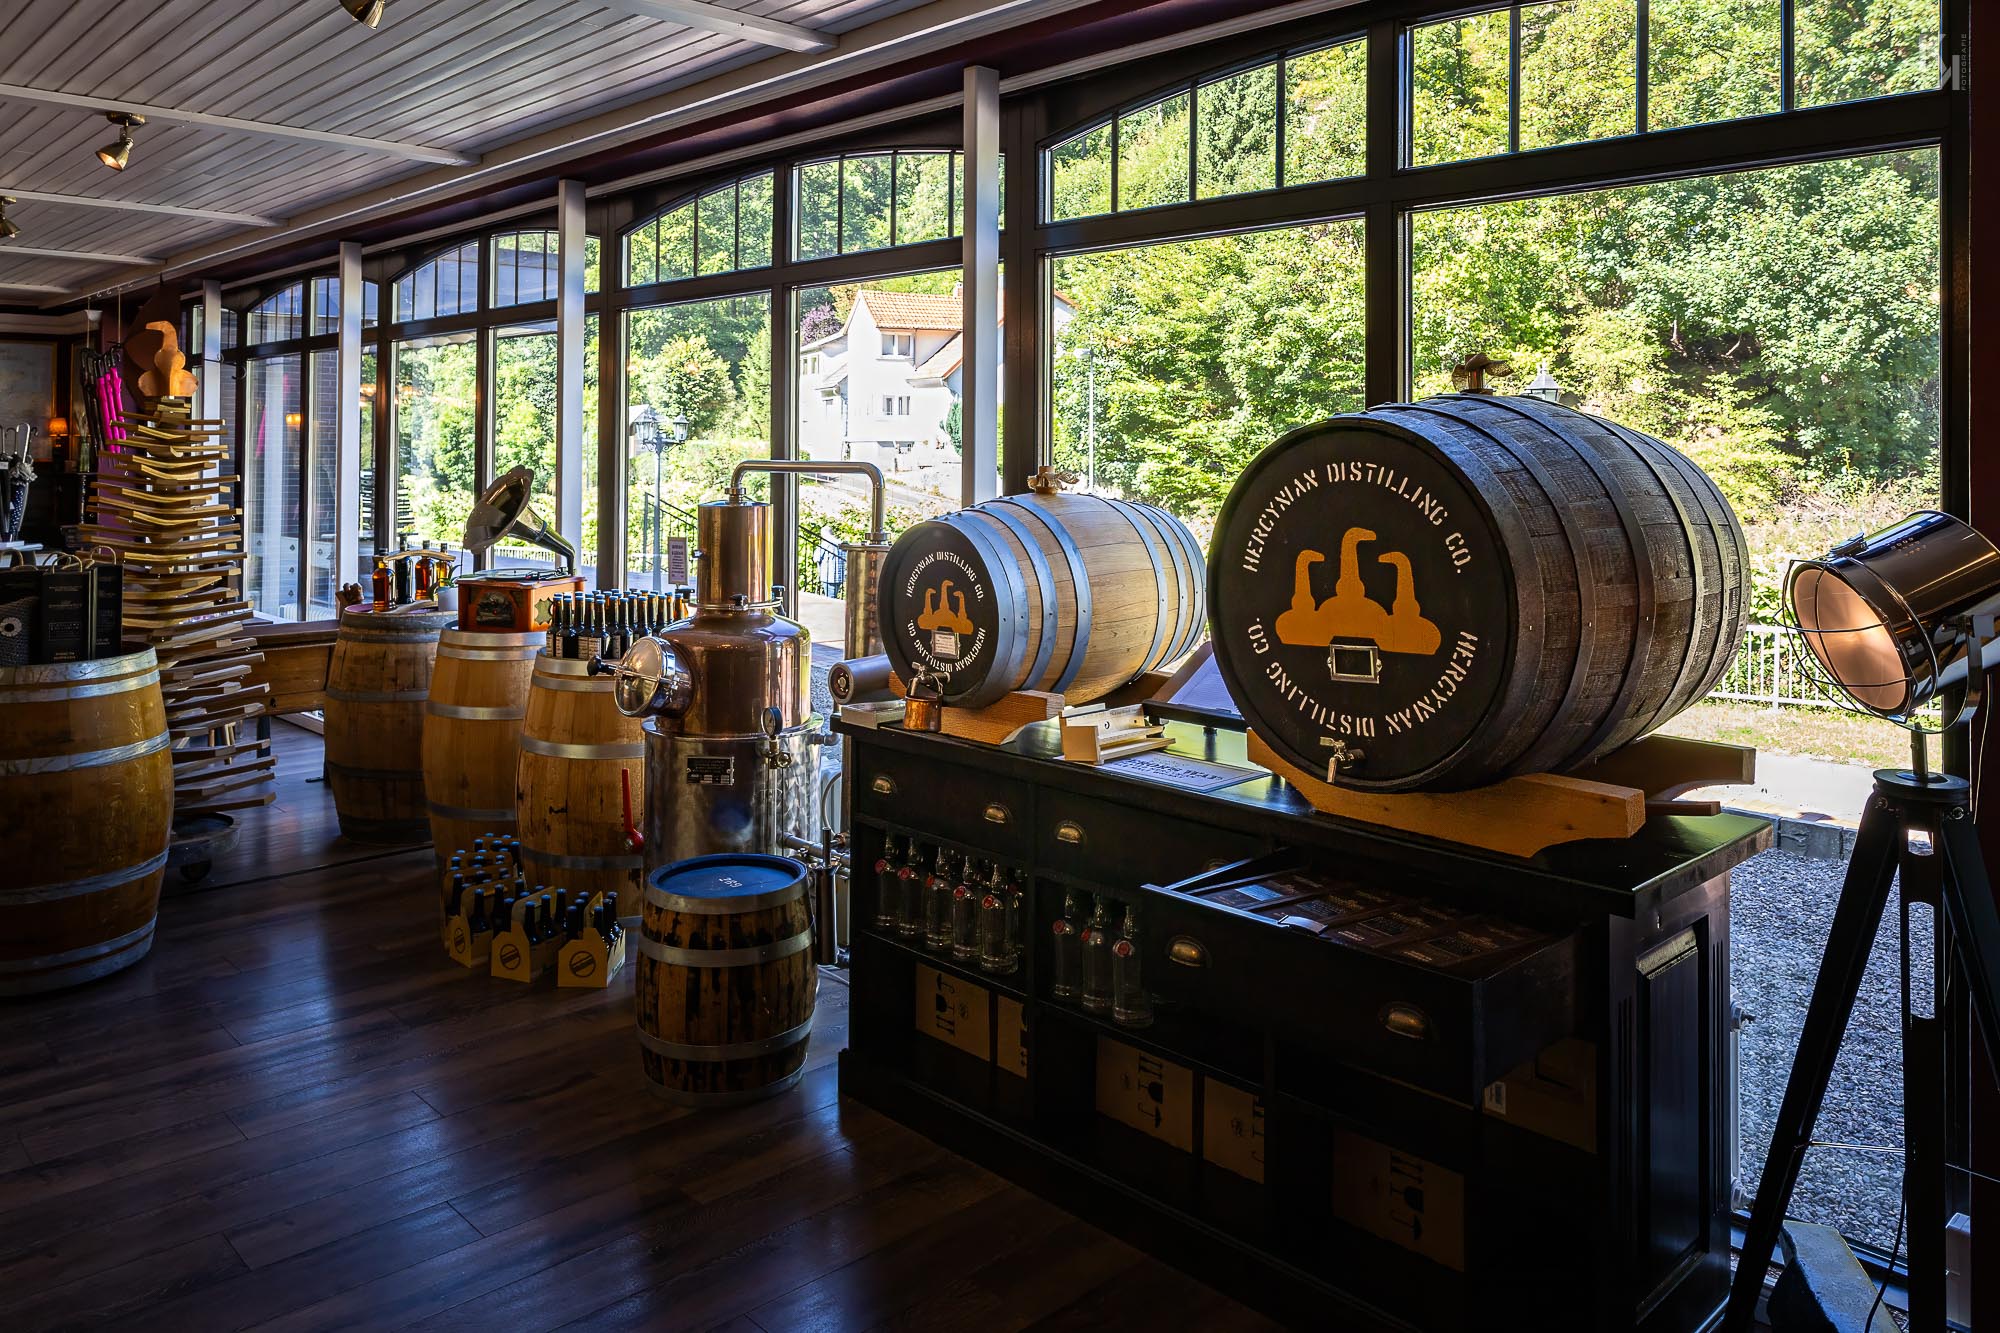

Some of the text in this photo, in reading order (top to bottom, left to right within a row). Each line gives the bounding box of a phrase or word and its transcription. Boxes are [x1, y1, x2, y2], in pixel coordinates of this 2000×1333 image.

[1242, 461, 1472, 575] HERCYNIAN DISTILLING CO.
[906, 551, 985, 602] HERCYNIAN DISTILLING CO.
[907, 619, 916, 637] CO.
[955, 627, 987, 672] HERCYNIAN
[913, 639, 953, 673] DISTILLING
[1247, 617, 1479, 738] HERCYNIAN DISTILLING CO.
